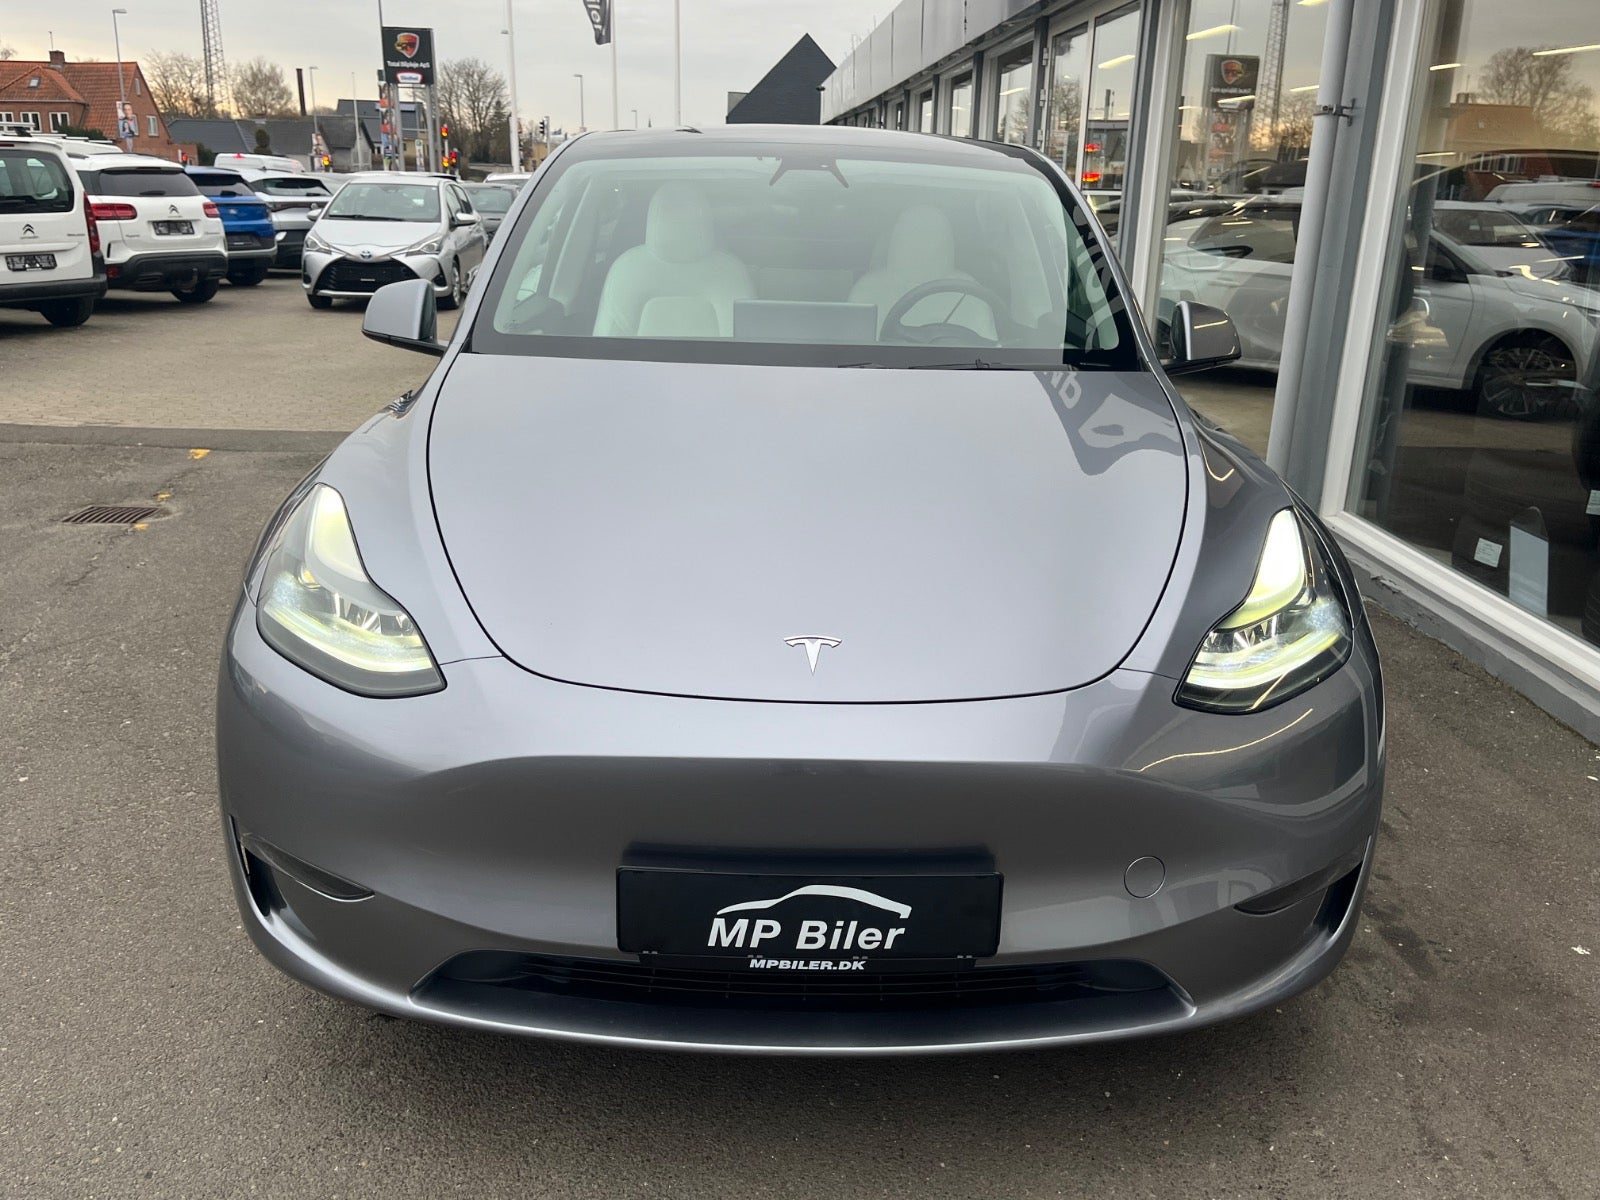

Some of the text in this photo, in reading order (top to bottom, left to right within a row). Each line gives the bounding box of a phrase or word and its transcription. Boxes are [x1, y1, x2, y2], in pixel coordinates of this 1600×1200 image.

[707, 917, 906, 950] MP Biler
[749, 958, 867, 971] MPBILER.DK
